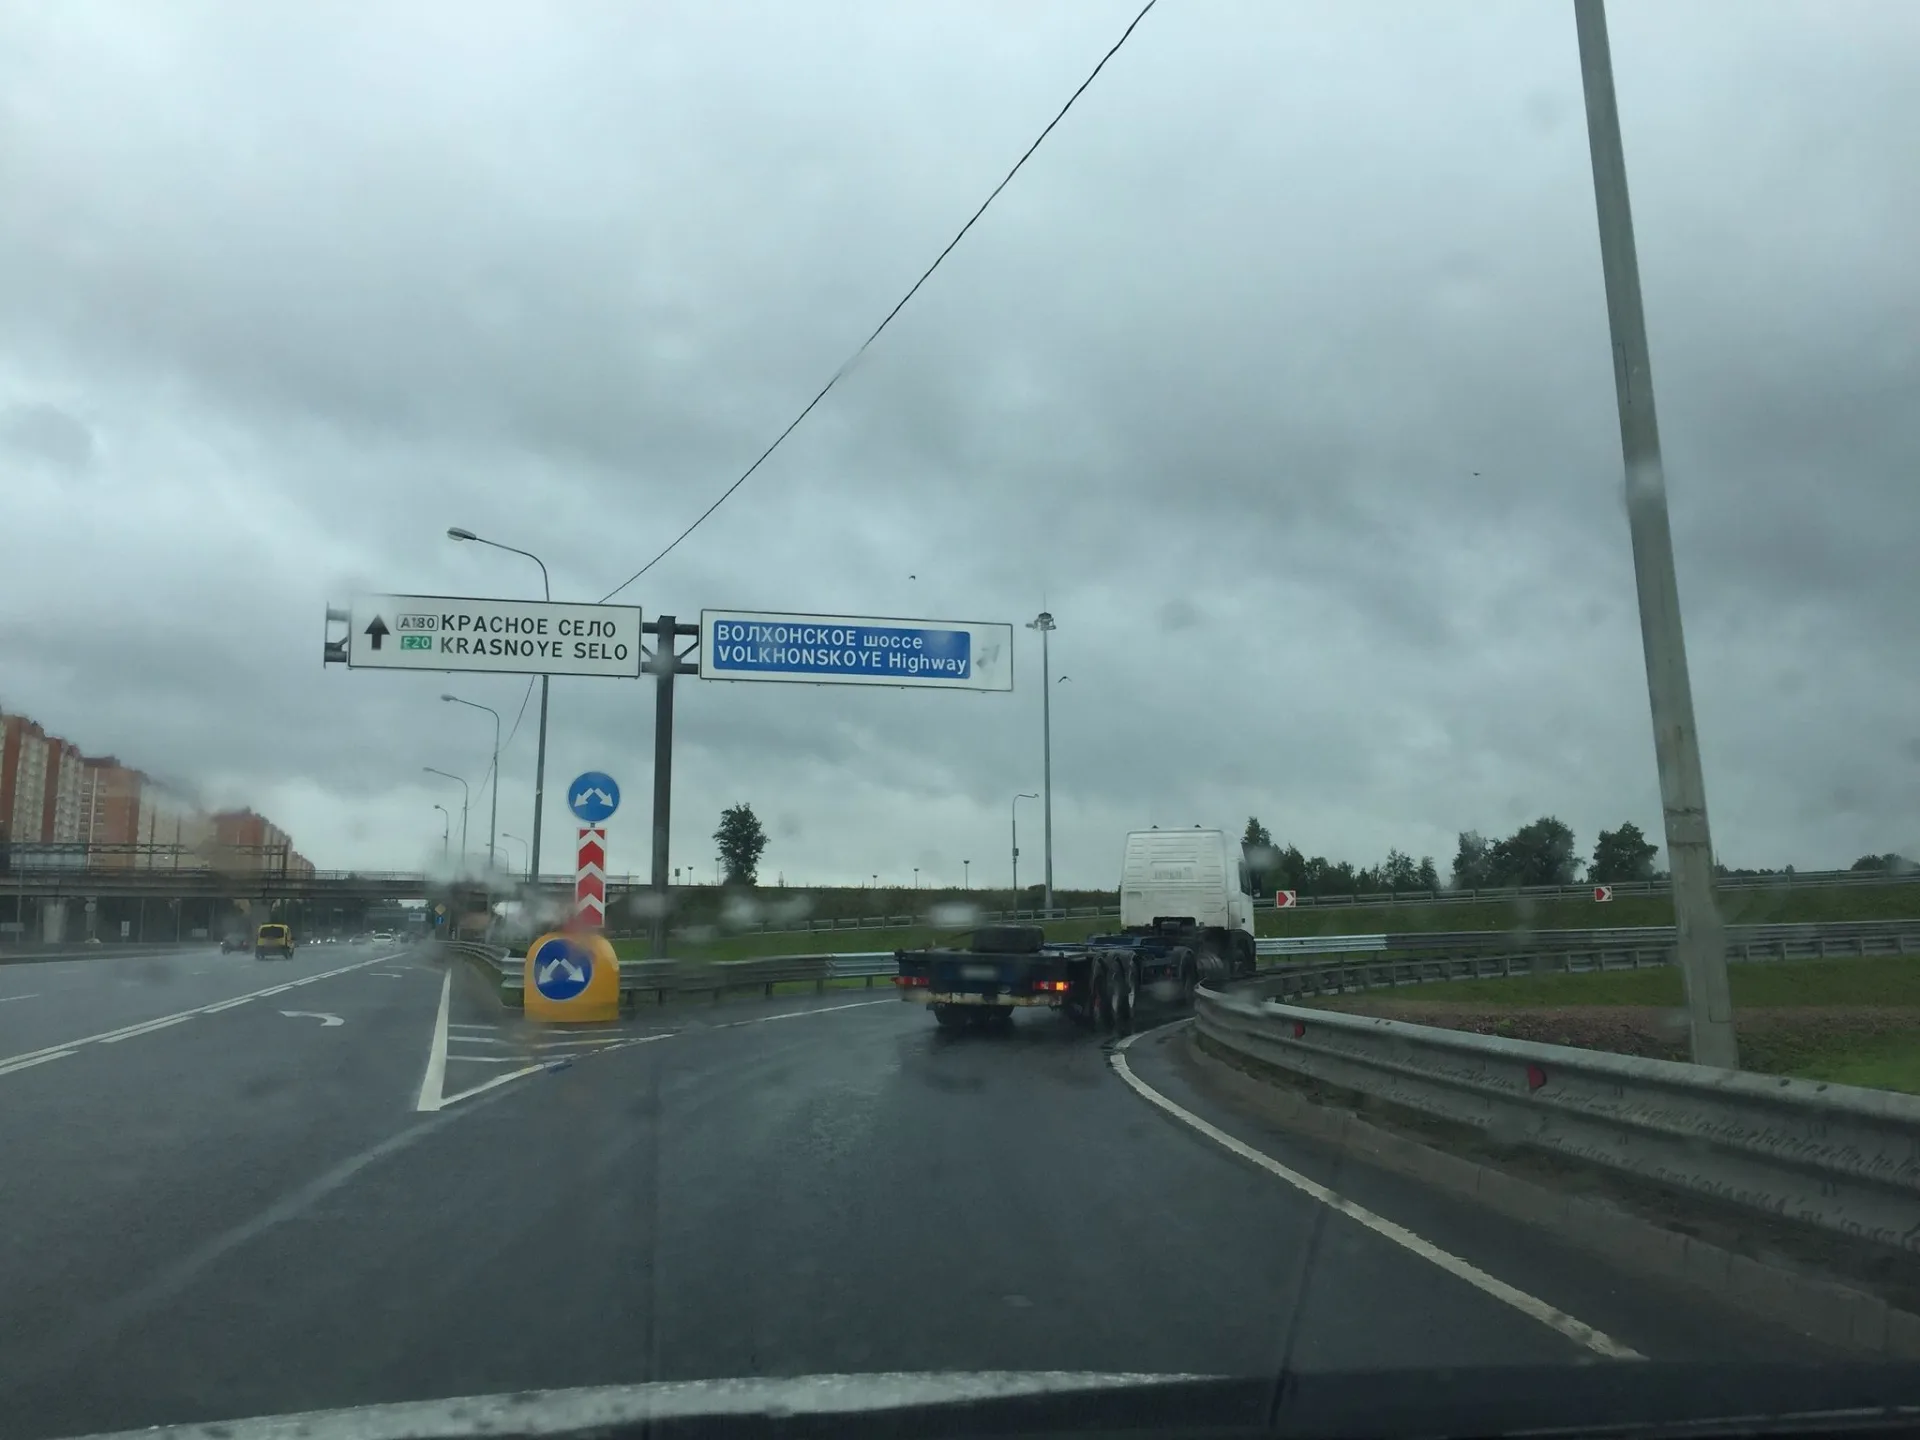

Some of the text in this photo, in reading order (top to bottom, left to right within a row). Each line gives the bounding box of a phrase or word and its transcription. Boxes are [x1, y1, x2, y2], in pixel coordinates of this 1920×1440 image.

[441, 614, 548, 635] КРАСНОЕ
[558, 619, 616, 638] СЕЛО
[717, 624, 923, 649] ВОЛХОНСКОЕ шоссе
[440, 637, 563, 658] KRASNOYE
[573, 642, 628, 661] SELO
[717, 645, 967, 674] VOLKHONSKOYE Highway
